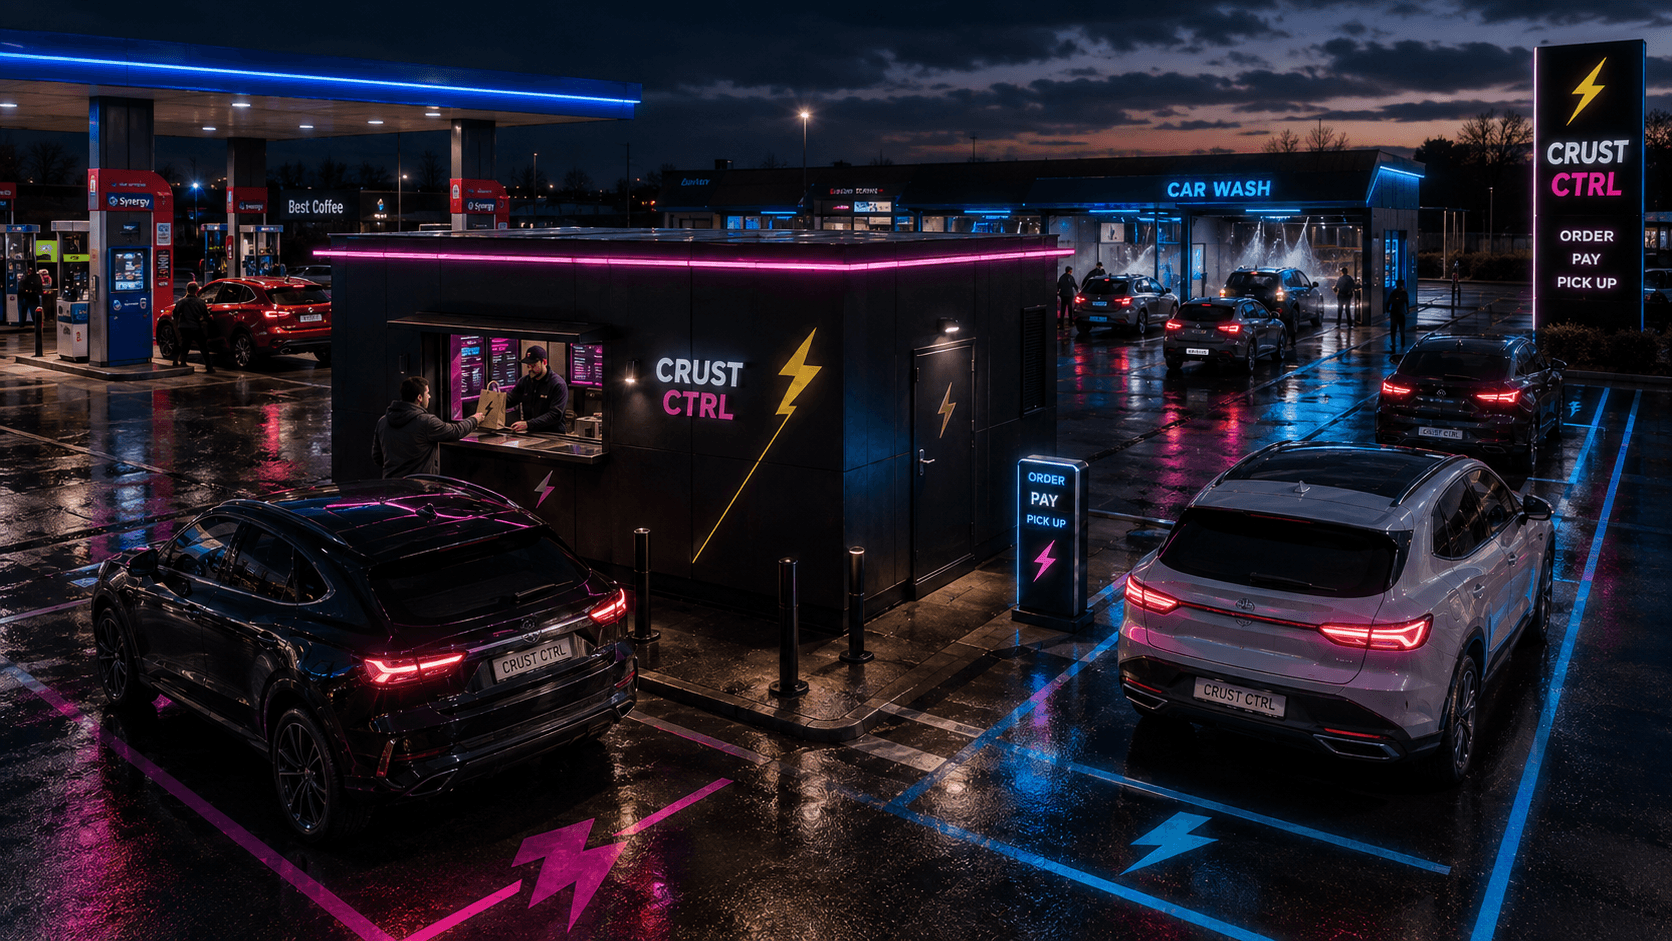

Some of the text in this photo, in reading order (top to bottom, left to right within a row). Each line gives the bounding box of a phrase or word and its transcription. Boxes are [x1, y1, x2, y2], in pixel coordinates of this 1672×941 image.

[1547, 139, 1629, 165] CRUST
[1167, 180, 1271, 198] CAR WASH
[1551, 172, 1622, 197] CTRL
[288, 199, 344, 214] Best Coffee
[1560, 229, 1614, 242] ORDER
[1572, 253, 1601, 265] PAY
[1557, 276, 1617, 289] PICK UP
[656, 357, 744, 387] CRUST
[662, 389, 734, 421] CTRL
[1028, 471, 1065, 486] ORDER
[1031, 491, 1058, 507] PAY
[1026, 514, 1066, 528] PICK UP
[502, 644, 566, 674] CRUST CTRL
[1204, 684, 1275, 710] CRUST CTRL
